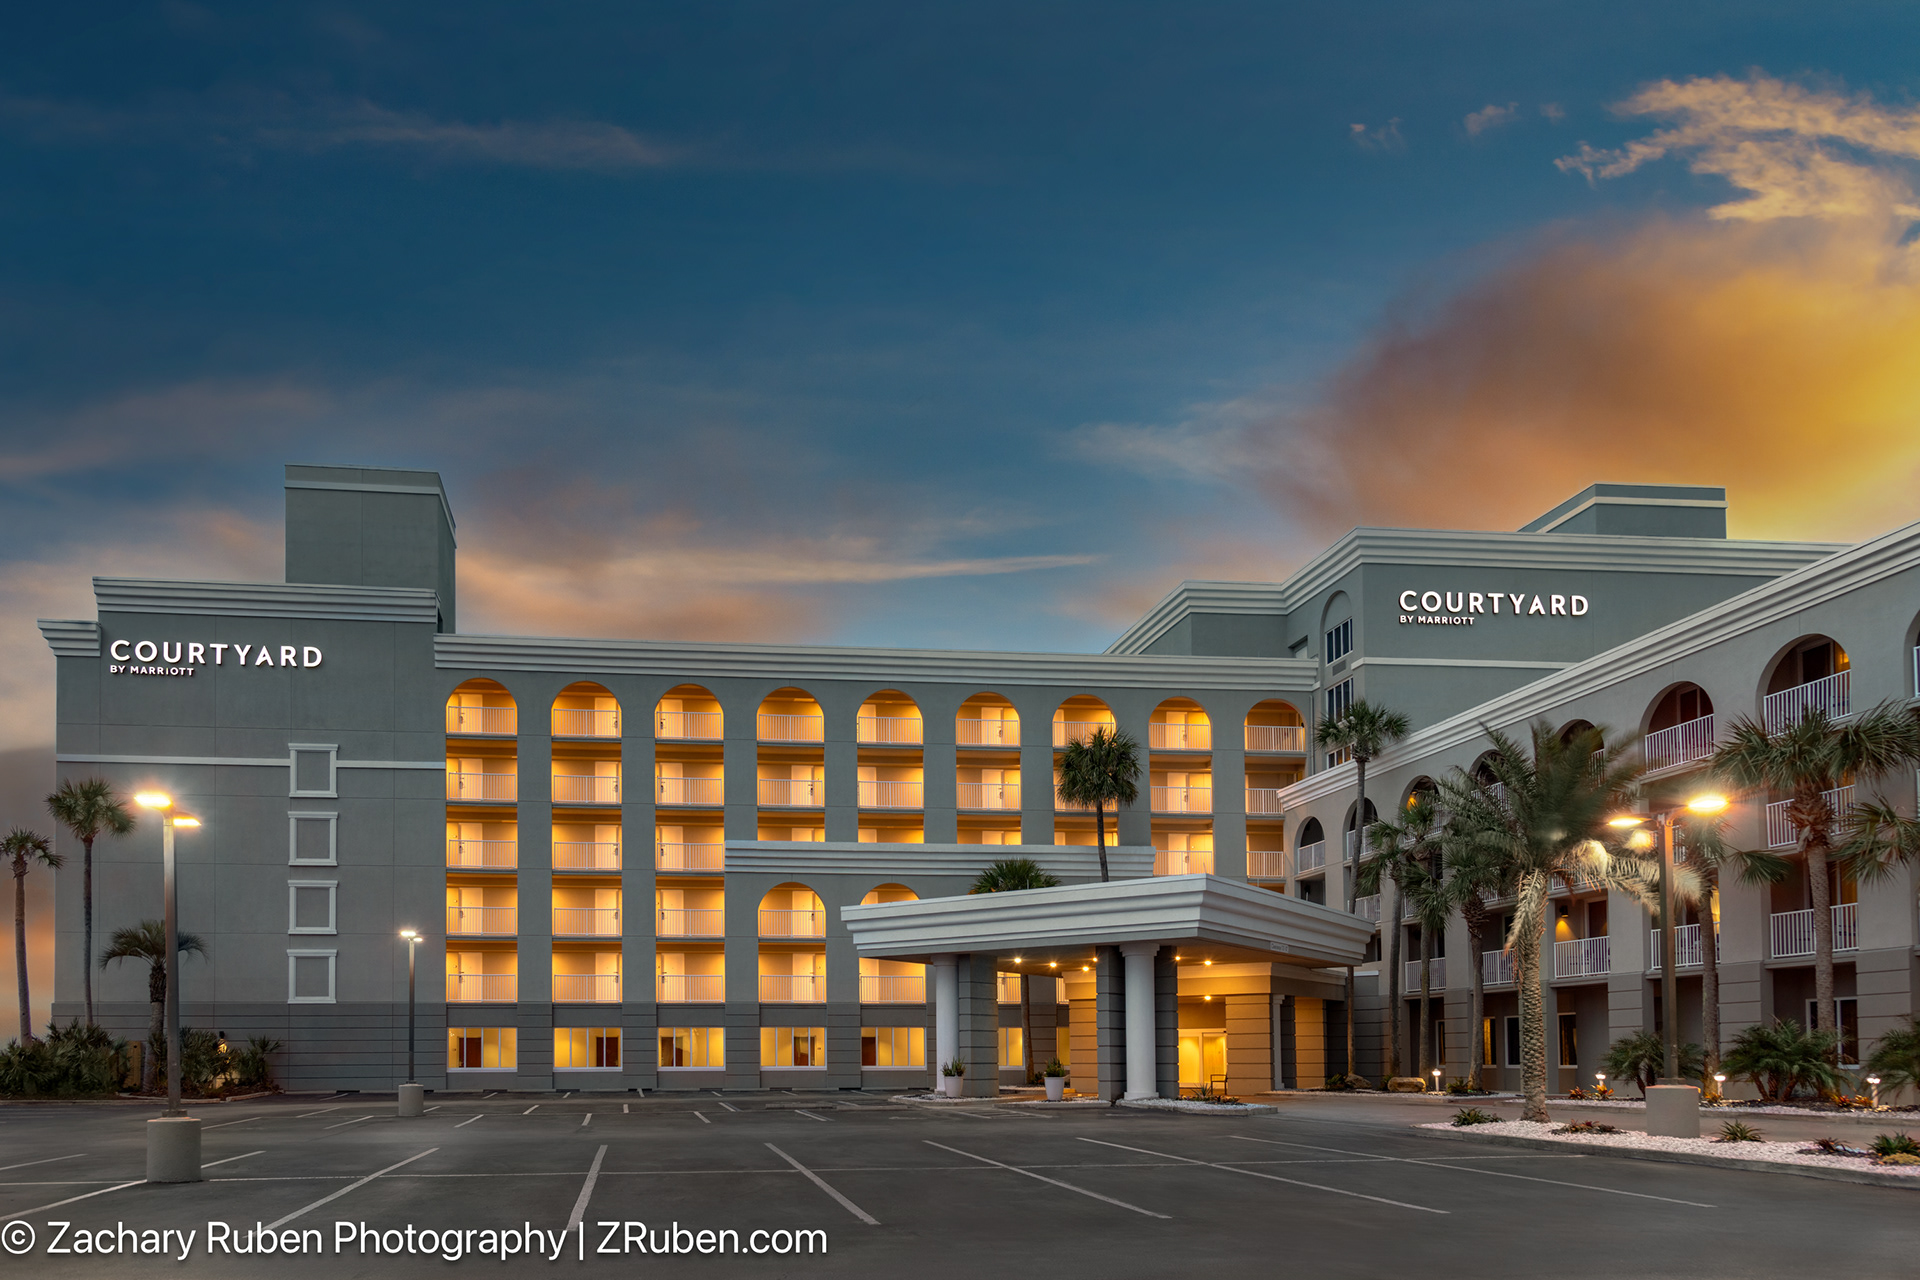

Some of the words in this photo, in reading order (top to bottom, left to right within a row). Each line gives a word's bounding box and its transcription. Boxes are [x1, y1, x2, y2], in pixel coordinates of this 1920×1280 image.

[1399, 590, 1589, 616] COURTYARD
[1399, 615, 1414, 624] BY
[1418, 615, 1475, 625] MARRIOTT
[109, 639, 322, 668] COURTYARD
[109, 664, 126, 674] BY
[130, 665, 195, 676] MARRIOTT
